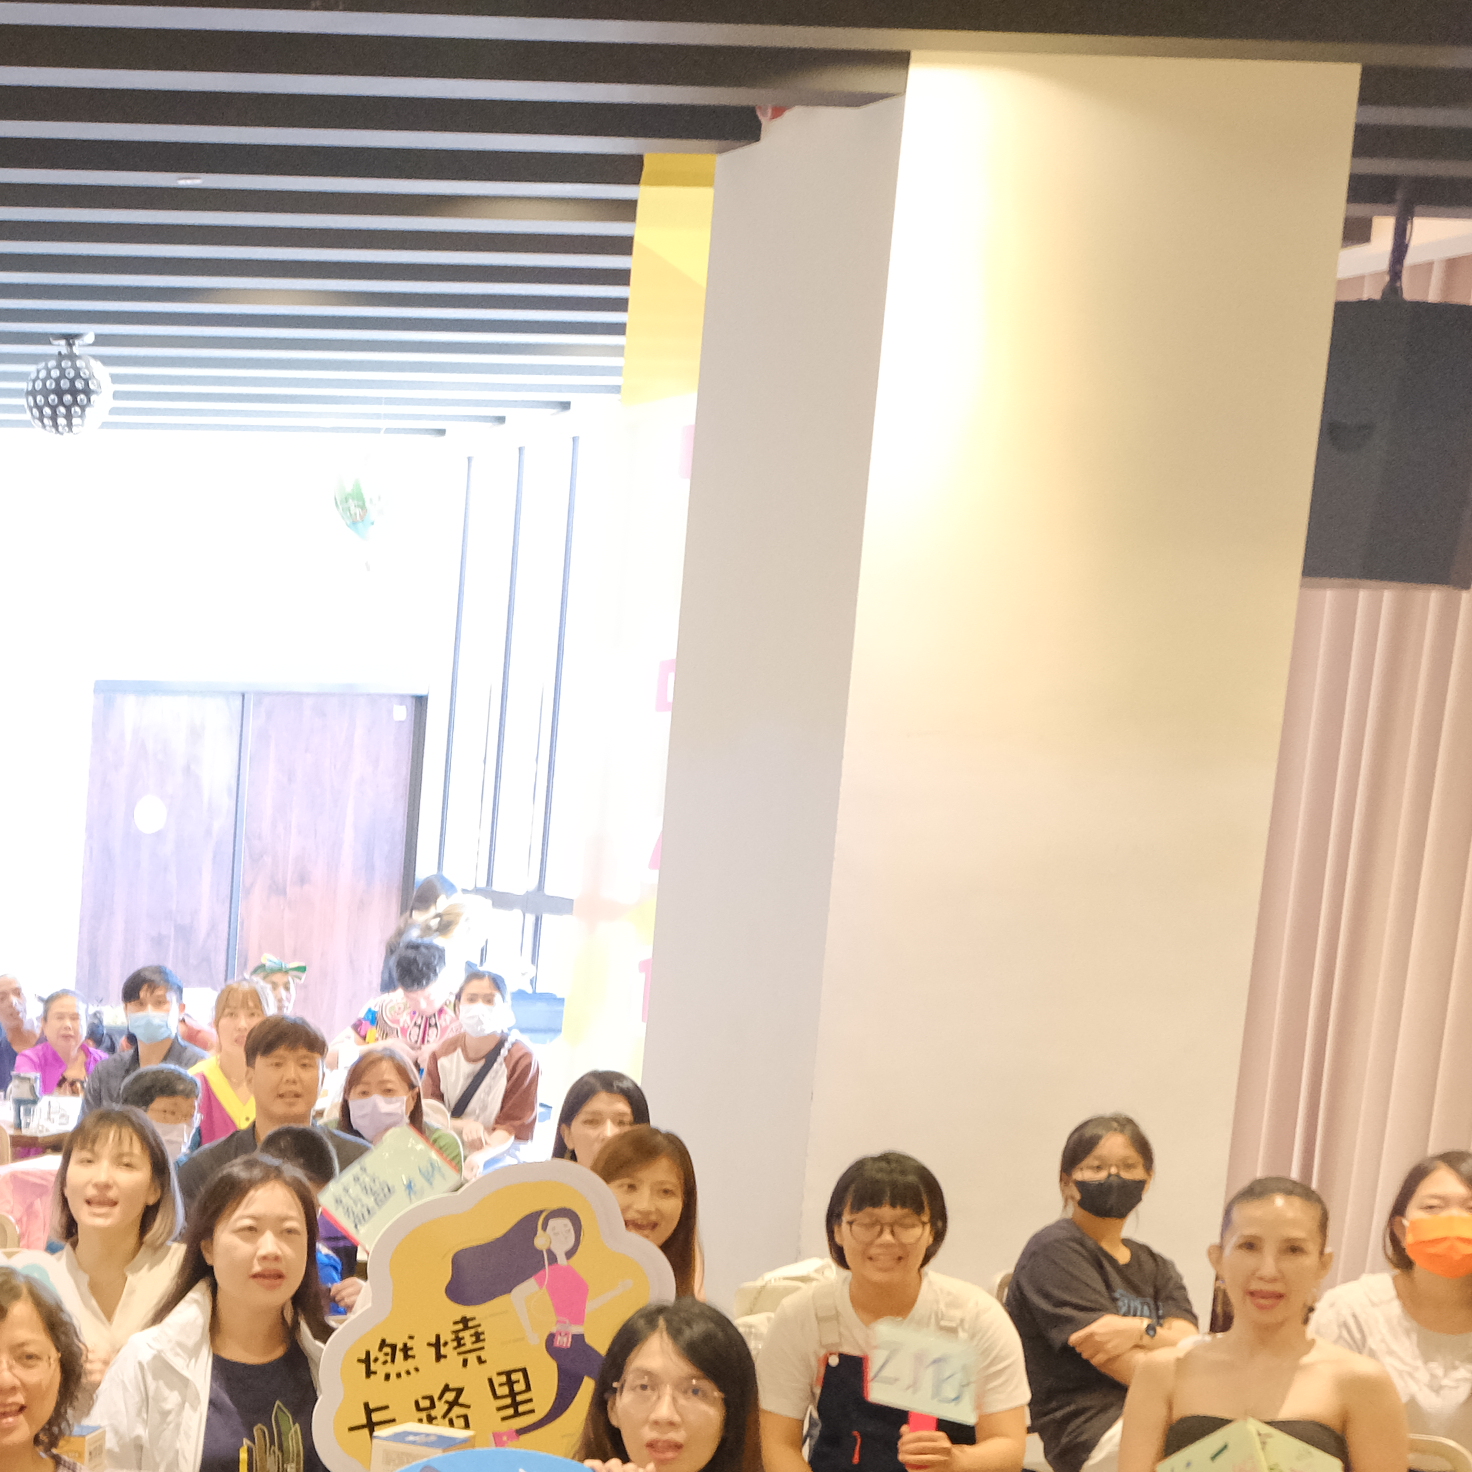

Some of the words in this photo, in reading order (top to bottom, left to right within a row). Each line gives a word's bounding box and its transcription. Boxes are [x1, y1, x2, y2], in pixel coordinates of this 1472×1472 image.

[356, 1316, 487, 1382] 燃燒
[348, 1366, 536, 1436] 卡路里
